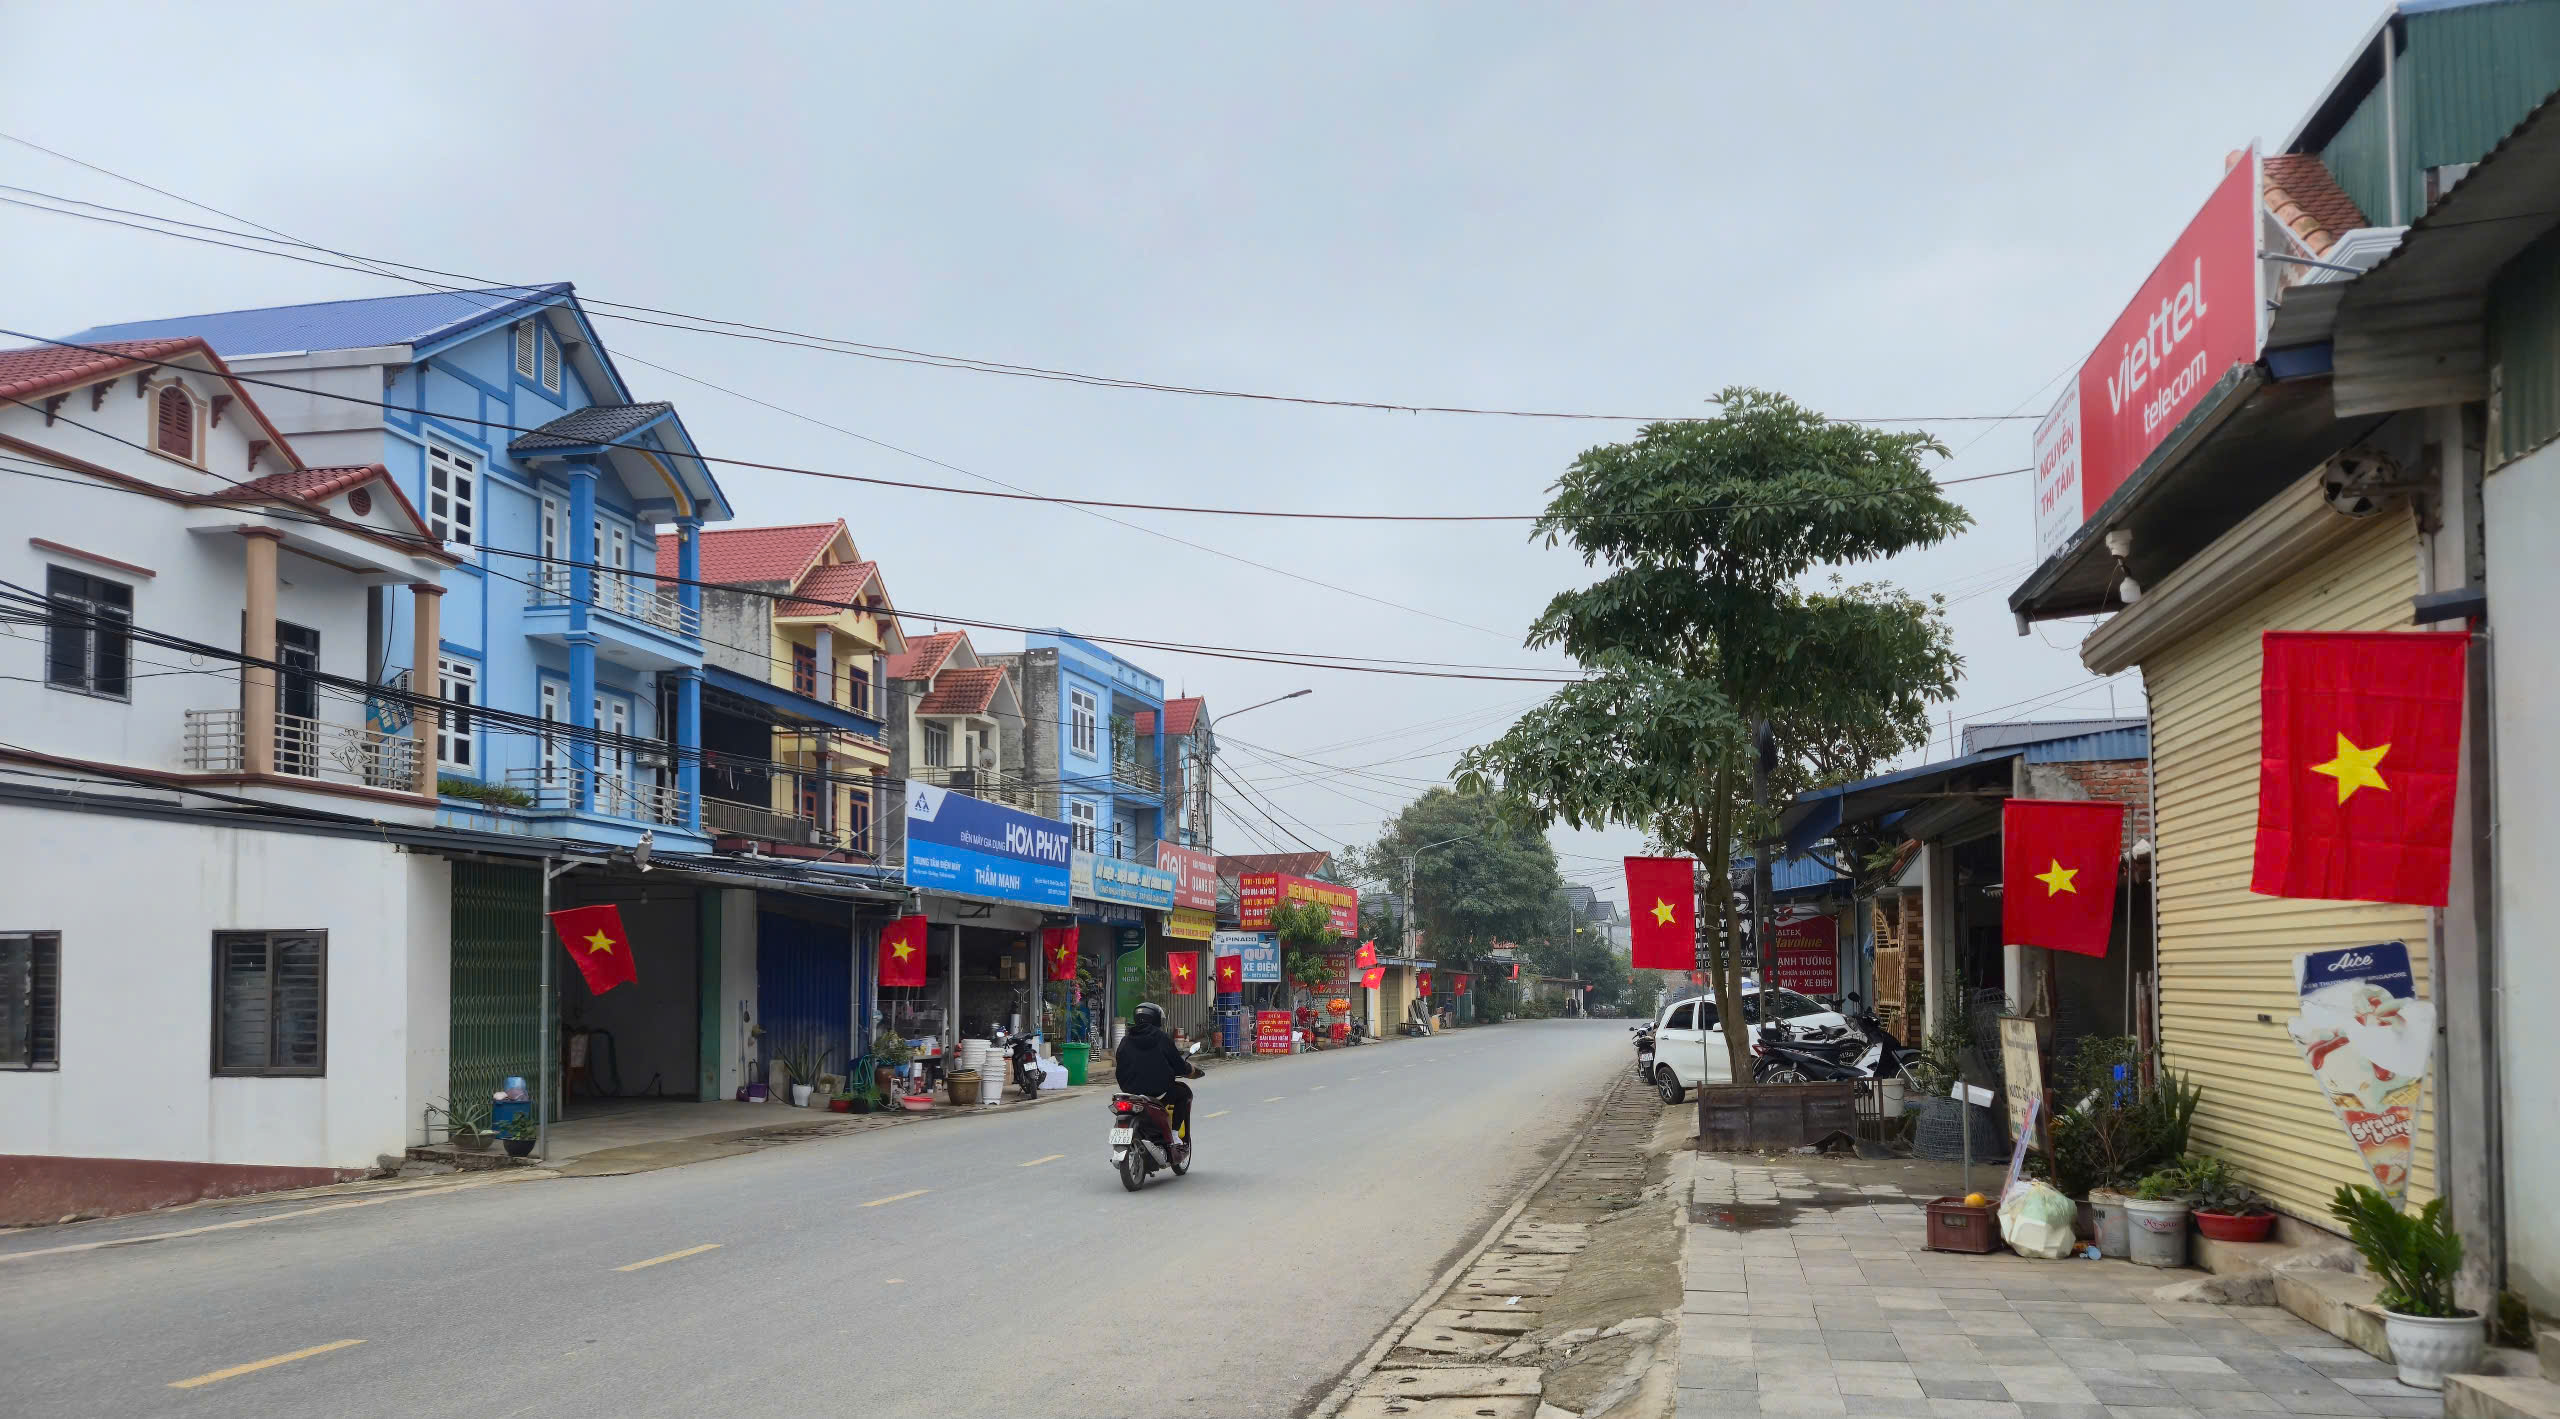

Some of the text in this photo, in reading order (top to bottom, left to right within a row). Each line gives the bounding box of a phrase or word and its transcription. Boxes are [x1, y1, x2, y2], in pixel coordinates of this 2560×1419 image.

[2108, 256, 2207, 415] viettel
[2144, 350, 2207, 434] telecom
[984, 837, 992, 848] GIA
[992, 839, 1005, 852] DỤNG
[1243, 961, 1278, 973] XE ĐIỆN
[1800, 954, 1832, 966] TƯỜNG
[2327, 952, 2374, 972] Aice
[1804, 979, 1814, 987] XE
[1815, 978, 1833, 988] ĐIỆN
[2351, 1114, 2396, 1141] Straw
[2371, 1119, 2413, 1143] berry
